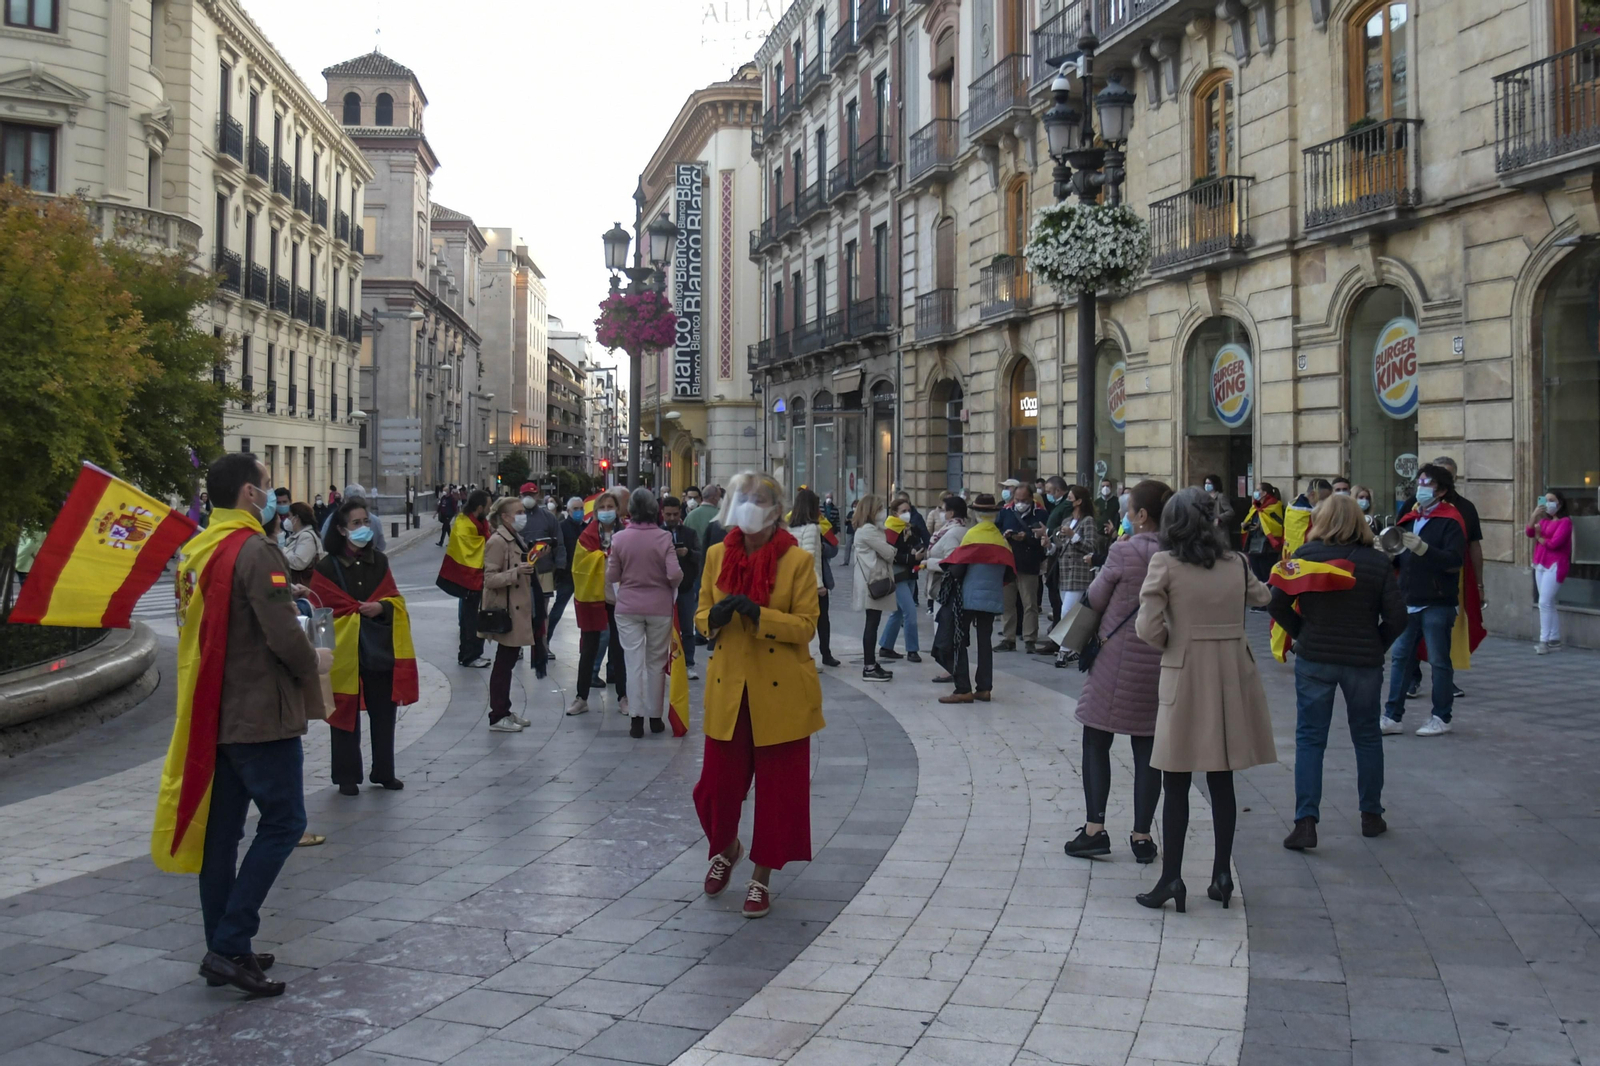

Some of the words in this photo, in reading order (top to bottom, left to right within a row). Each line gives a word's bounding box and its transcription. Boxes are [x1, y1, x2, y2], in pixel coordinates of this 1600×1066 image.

[677, 201, 686, 229] Blanco
[675, 230, 687, 282] Blanco
[683, 234, 701, 312] Blanco
[675, 283, 683, 317] Blanco
[690, 315, 701, 351] Blanco
[675, 318, 691, 395] Blanco
[1375, 336, 1416, 373] BURGER
[1214, 359, 1245, 389] BURGER
[1215, 373, 1246, 407] KING
[1377, 352, 1417, 395] KING
